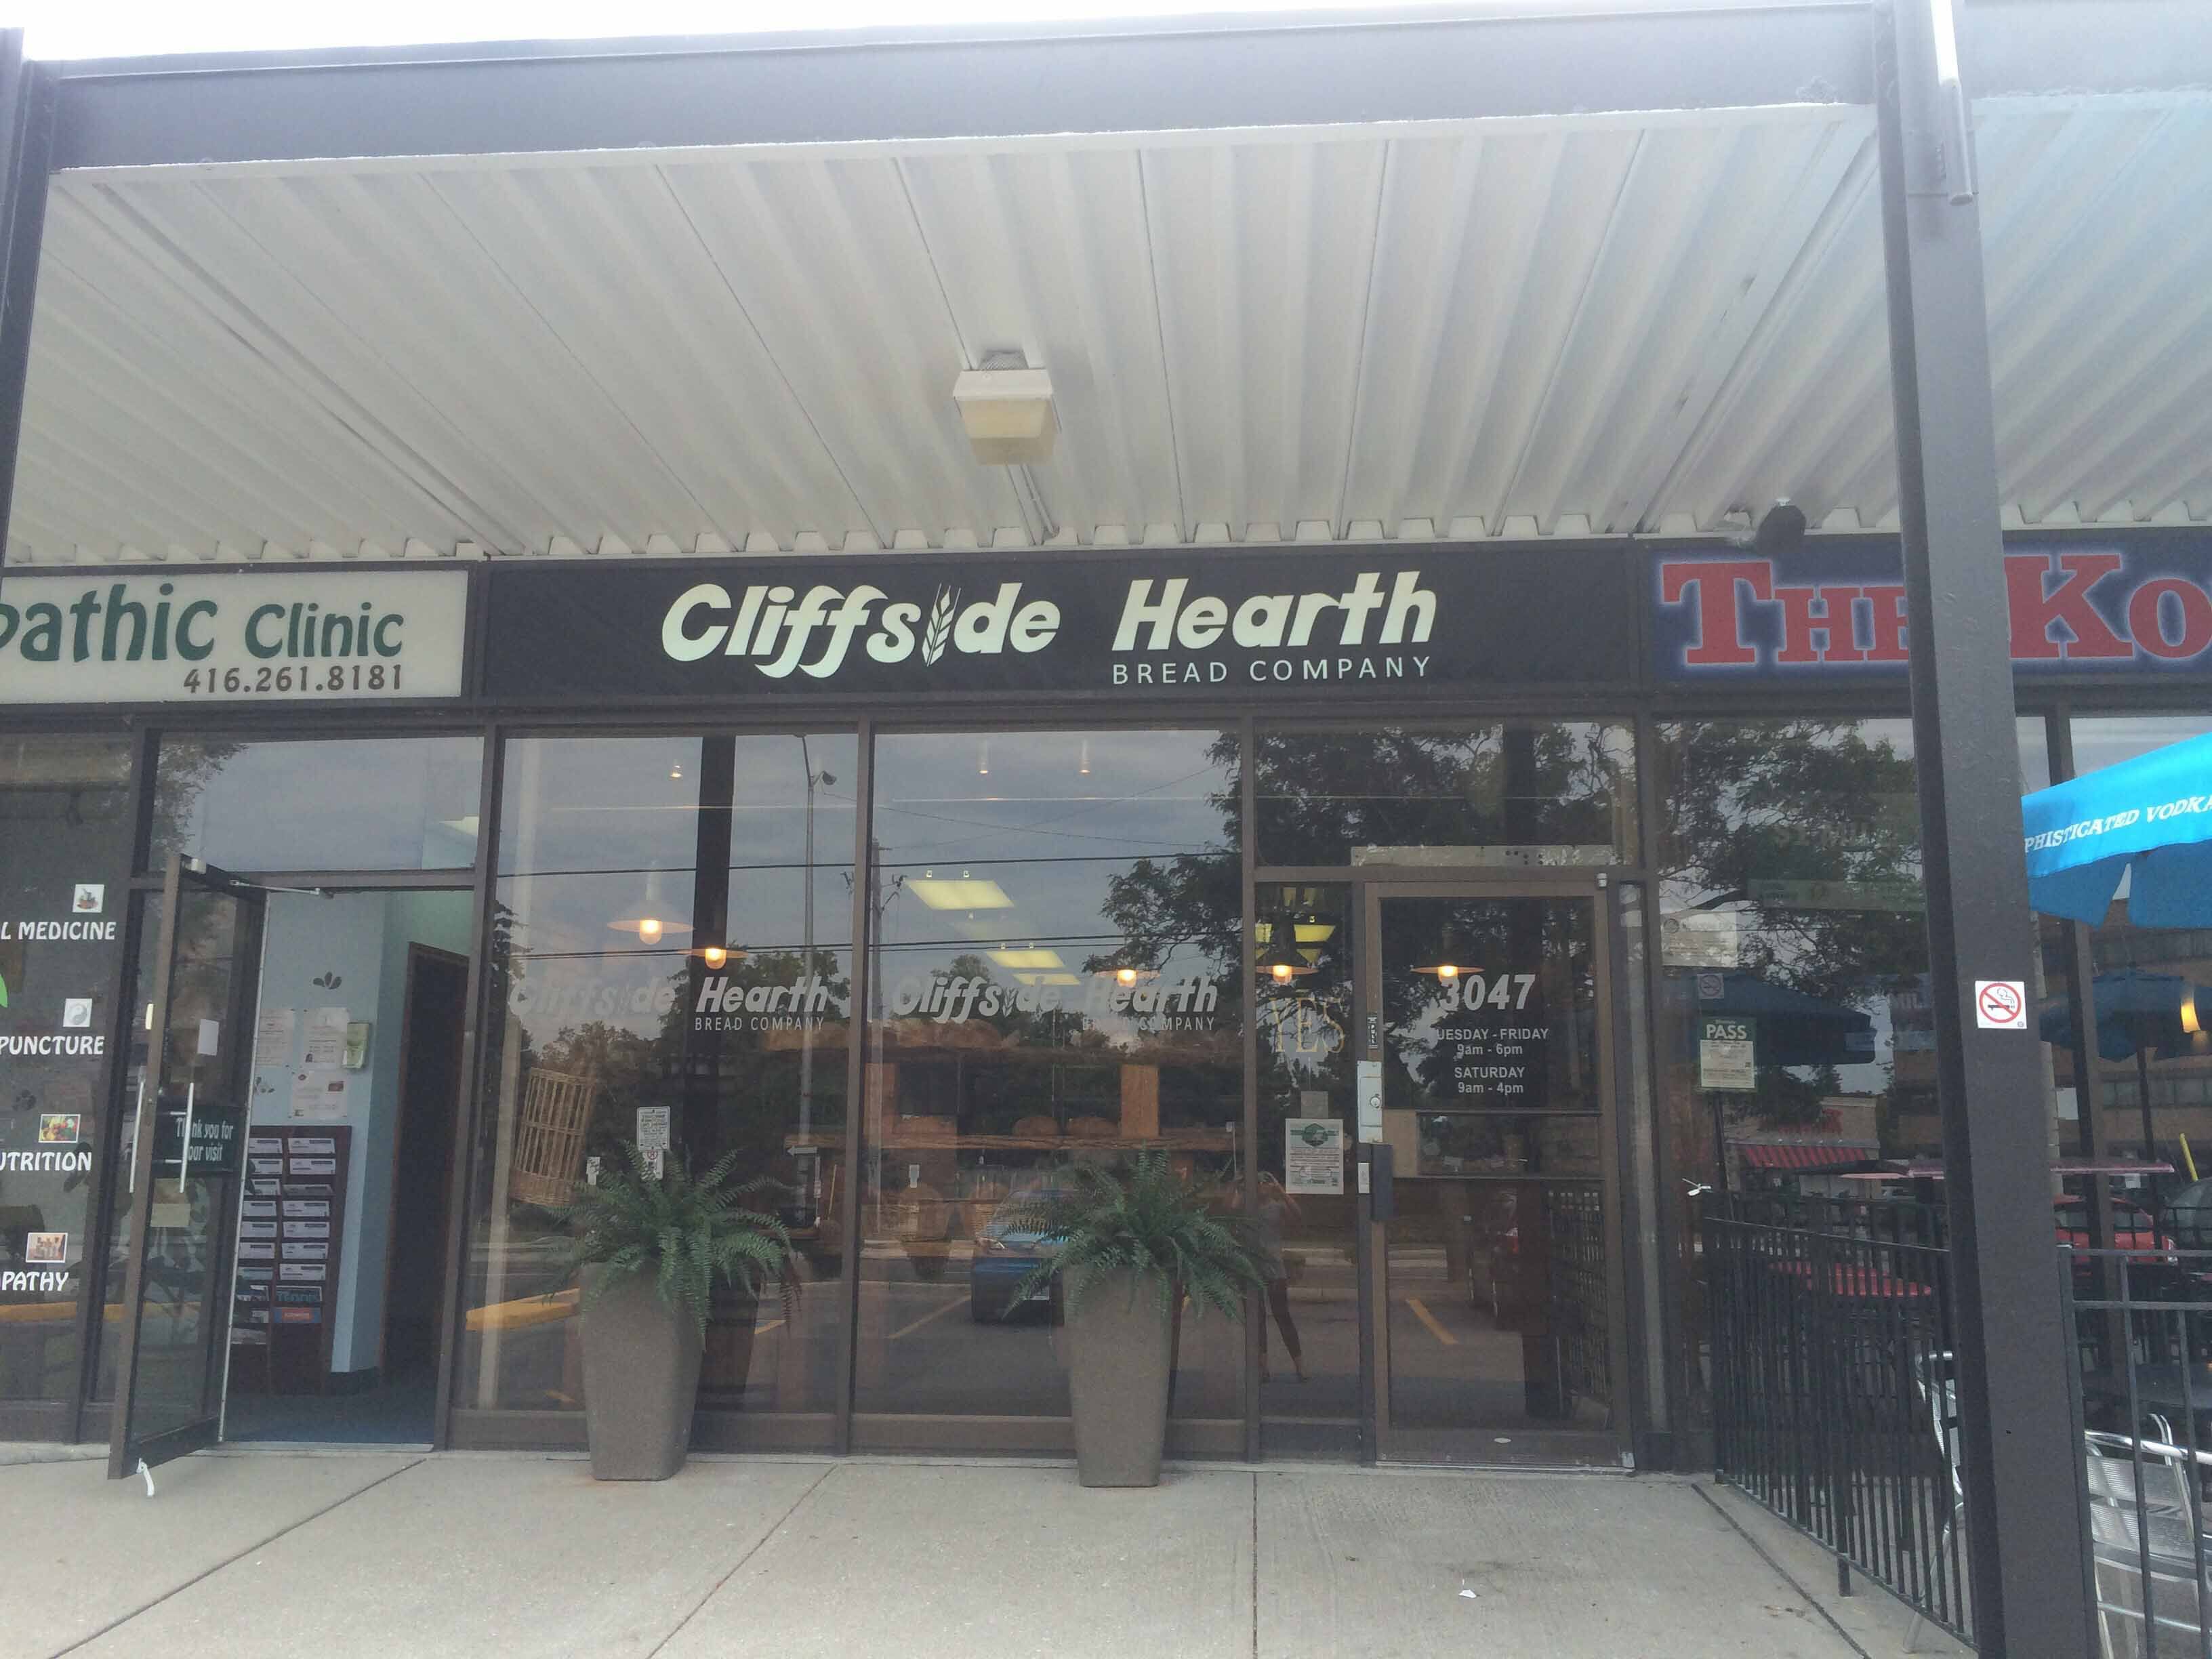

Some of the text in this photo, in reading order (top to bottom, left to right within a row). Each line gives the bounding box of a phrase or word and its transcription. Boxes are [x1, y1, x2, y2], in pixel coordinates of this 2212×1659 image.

[1111, 571, 1437, 651] Hearth
[245, 602, 405, 659] Clinic
[183, 664, 402, 693] 416.261.8181
[1112, 656, 1431, 684] BREAD COMPANY
[18, 921, 117, 940] MEDICINE
[695, 975, 828, 1013] Hearth
[1438, 974, 1536, 1010] 3047
[695, 1017, 825, 1031] BREAD COMPANY
[1500, 1028, 1549, 1040] FRIDAY
[1705, 1023, 1747, 1040] PASS
[0, 1036, 105, 1055] PUNCTURE
[1457, 1044, 1483, 1055] 9am
[1496, 1044, 1523, 1057] 6pm
[1454, 1067, 1525, 1078] SATURDAY
[1458, 1082, 1484, 1093] 9am
[1496, 1082, 1524, 1096] 4pm
[176, 1117, 234, 1139] Thnk you for
[205, 1142, 223, 1162] visit
[3, 1271, 70, 1292] PATHY
